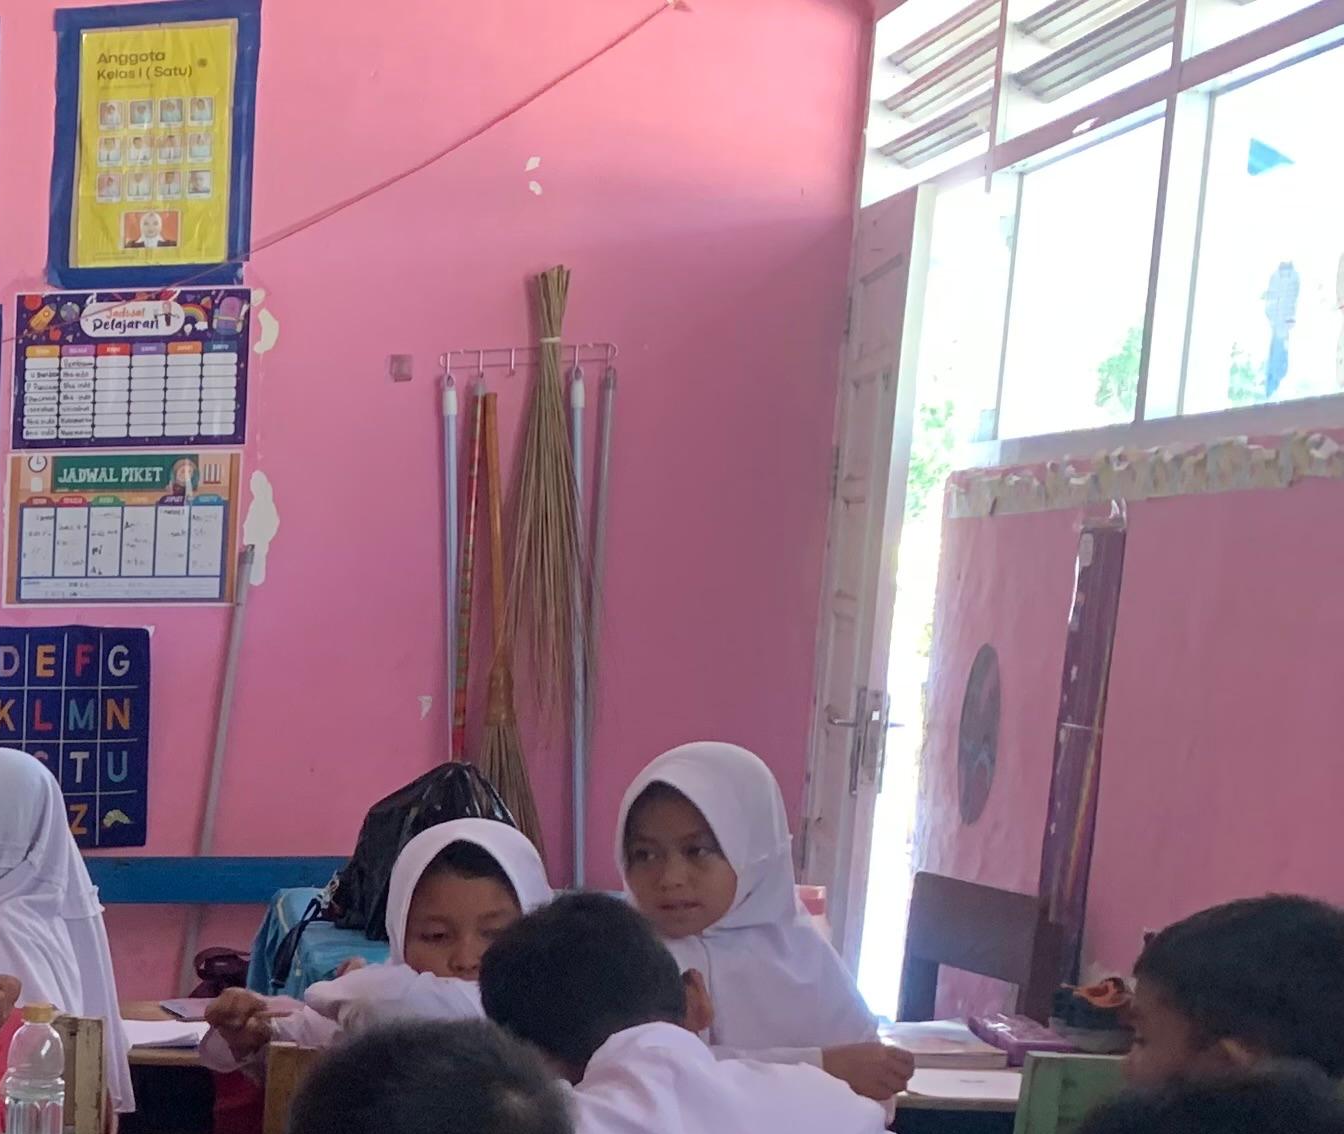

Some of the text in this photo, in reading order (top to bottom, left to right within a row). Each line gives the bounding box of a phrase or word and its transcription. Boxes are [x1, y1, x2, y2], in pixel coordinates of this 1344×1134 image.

[96, 50, 166, 66] Anggota
[96, 69, 136, 81] Kelas
[92, 316, 159, 335] Pelajaran
[58, 467, 164, 484] JADWAL PIKET
[36, 644, 57, 678] E
[74, 644, 95, 676] F
[107, 645, 130, 676] G
[34, 699, 53, 731] L
[68, 699, 95, 731] M
[106, 698, 131, 731] N
[69, 751, 90, 783] T
[107, 751, 129, 783] U
[69, 804, 88, 835] Z
